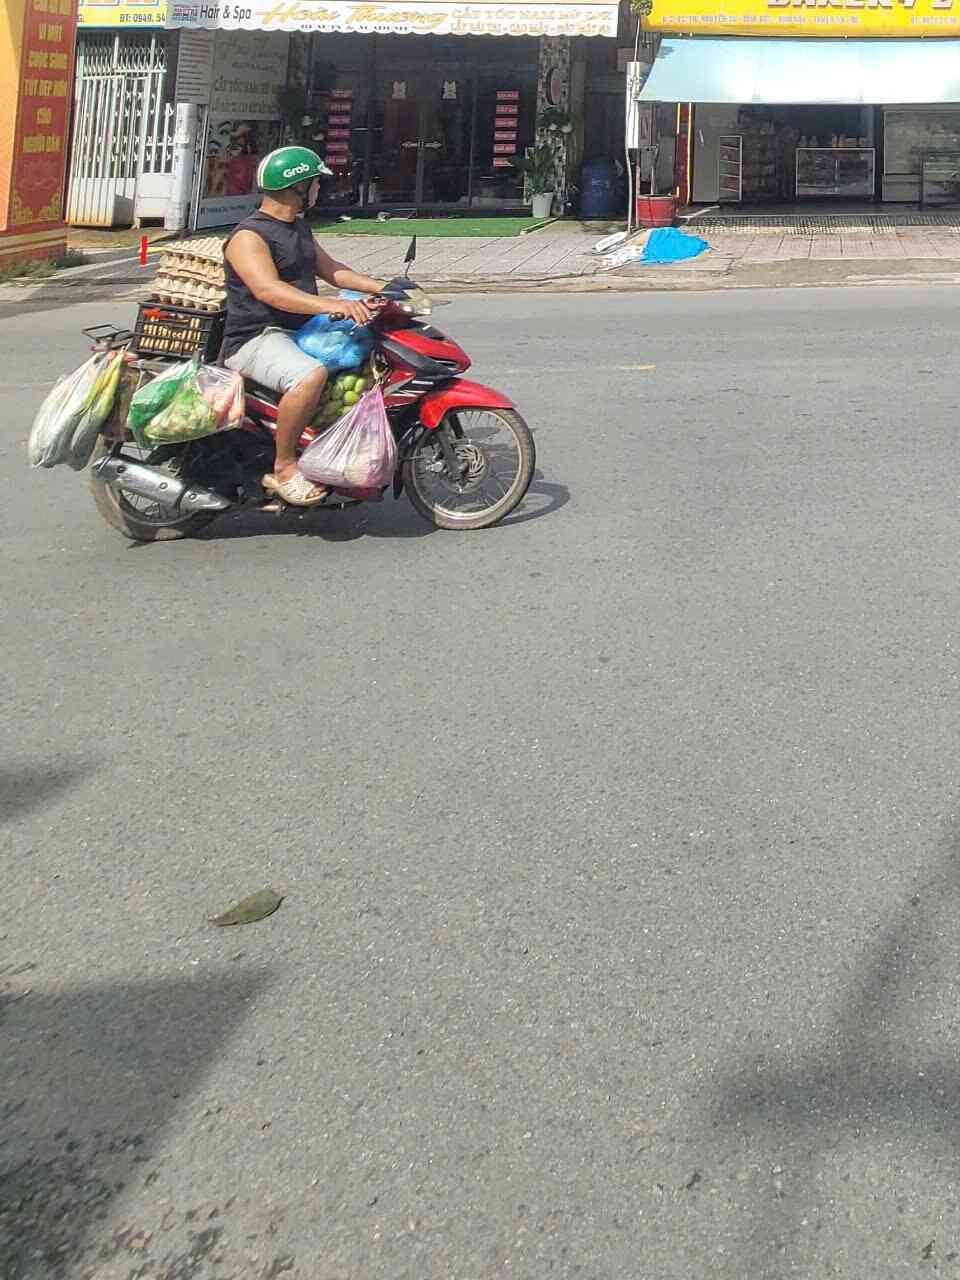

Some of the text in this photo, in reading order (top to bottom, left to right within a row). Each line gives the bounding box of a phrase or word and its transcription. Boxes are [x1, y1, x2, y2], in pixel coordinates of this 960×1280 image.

[200, 5, 220, 19] Hair
[223, 5, 230, 19] &
[232, 5, 252, 22] Spa
[283, 163, 310, 178] Grab
